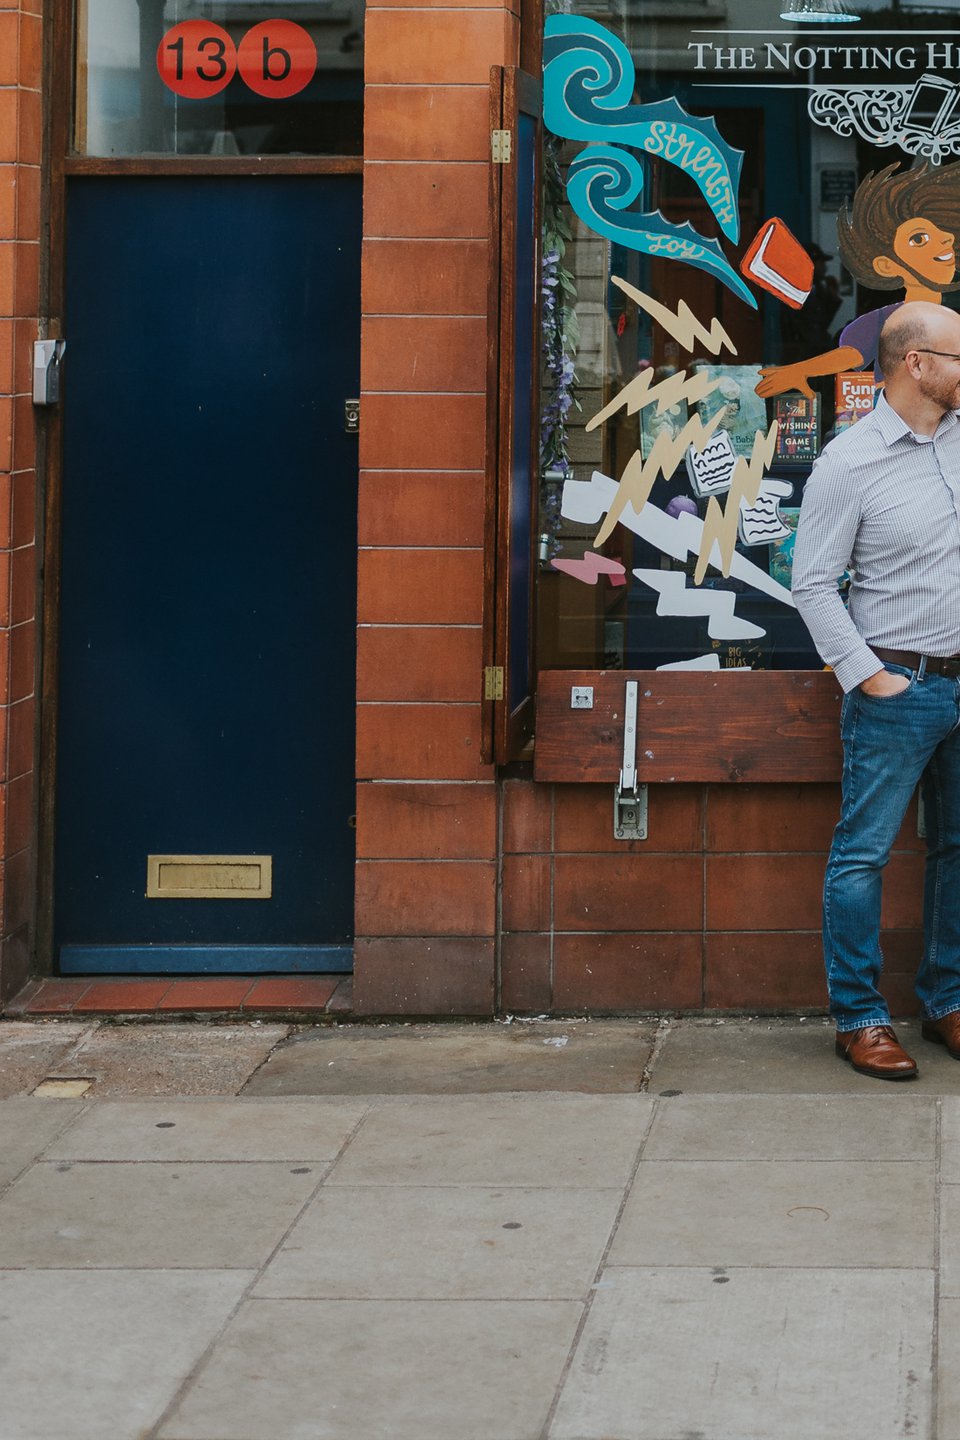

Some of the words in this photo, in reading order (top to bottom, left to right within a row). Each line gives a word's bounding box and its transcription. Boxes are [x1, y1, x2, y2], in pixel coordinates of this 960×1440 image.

[167, 37, 228, 82] 13
[262, 37, 292, 82] b
[687, 42, 757, 70] THE
[765, 42, 916, 70] NOTTING
[845, 394, 874, 409] Sto
[778, 421, 817, 430] WISHING
[728, 647, 742, 657] BIG
[725, 657, 747, 667] IDEAS
